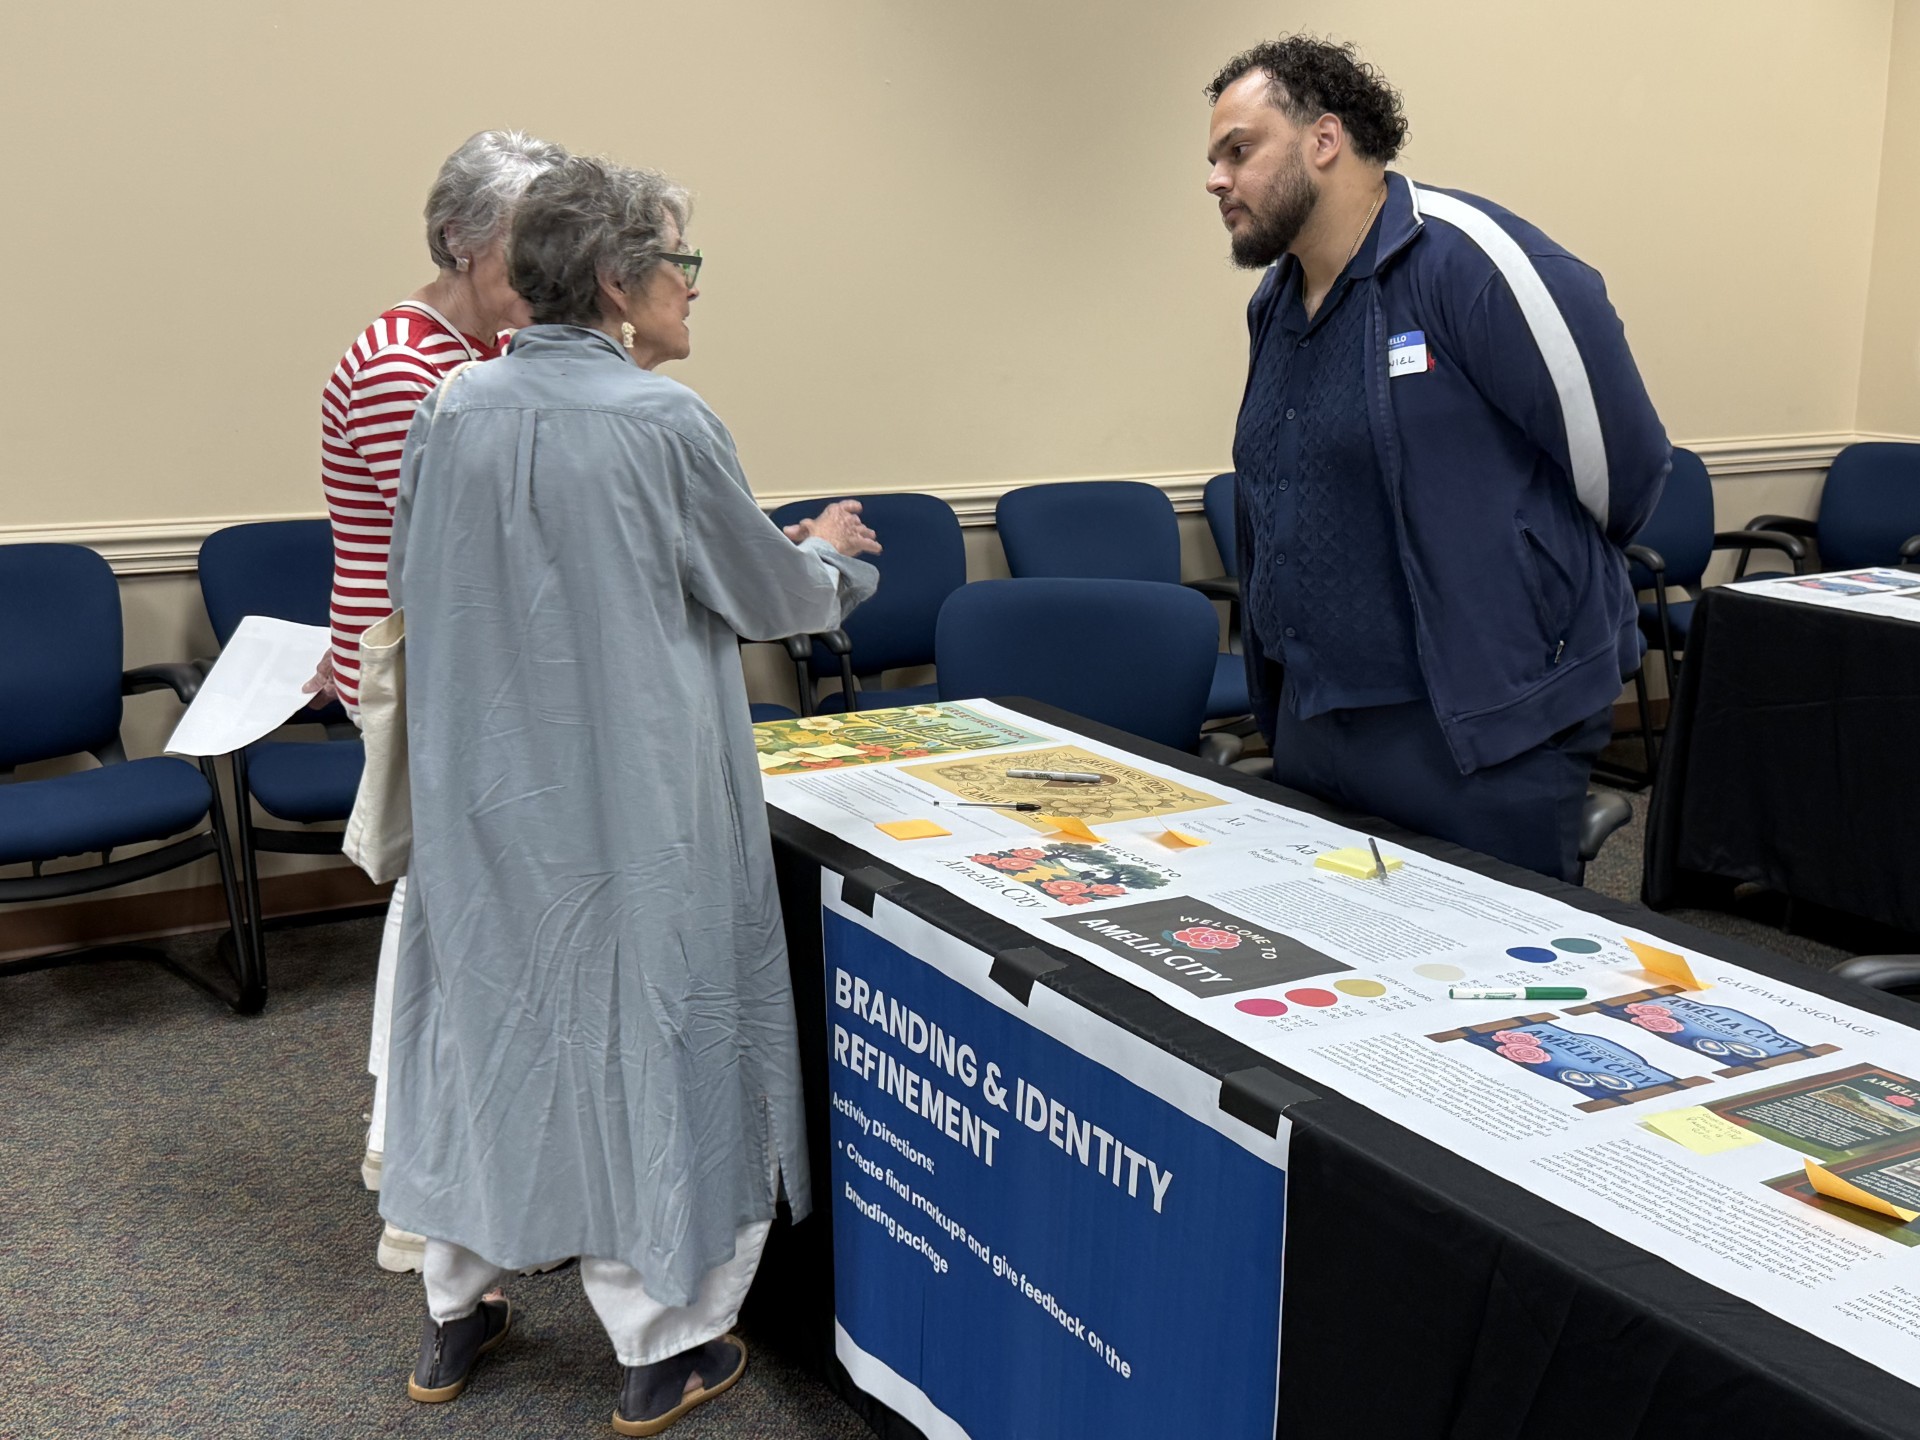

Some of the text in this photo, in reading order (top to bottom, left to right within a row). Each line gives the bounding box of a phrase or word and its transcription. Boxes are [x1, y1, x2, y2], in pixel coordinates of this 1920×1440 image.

[1388, 335, 1406, 346] ELLO
[999, 727, 1031, 740] FROM
[1100, 843, 1182, 879] WELCOME TO
[1286, 843, 1318, 856] Aa
[936, 859, 1048, 909] Amelia City
[1078, 918, 1233, 983] AMELIA CITY
[1179, 915, 1278, 960] WELCOME TO
[1374, 973, 1435, 1003] ACCENT COLORS
[1661, 998, 1799, 1051] AMELIA CITY
[1684, 1012, 1740, 1038] WELCOME
[1716, 976, 1881, 1038] GATEWAY SIGNAGE
[1524, 1030, 1660, 1084] AMELIA CITY
[1567, 1035, 1643, 1070] WELCOME TO
[834, 1023, 1000, 1168] REFINEMENT
[835, 967, 1174, 1215] BRANDING & IDENTITY
[1863, 1077, 1920, 1102] AMELI
[833, 1091, 935, 1176] Activity Directions:
[845, 1181, 949, 1274] branding package
[846, 1143, 1131, 1379] Create final markups and give feedback on the
[1844, 1301, 1868, 1312] and
[1892, 1284, 1912, 1296] The
[1832, 1304, 1863, 1322] scape.
[1855, 1297, 1906, 1321] maritime
